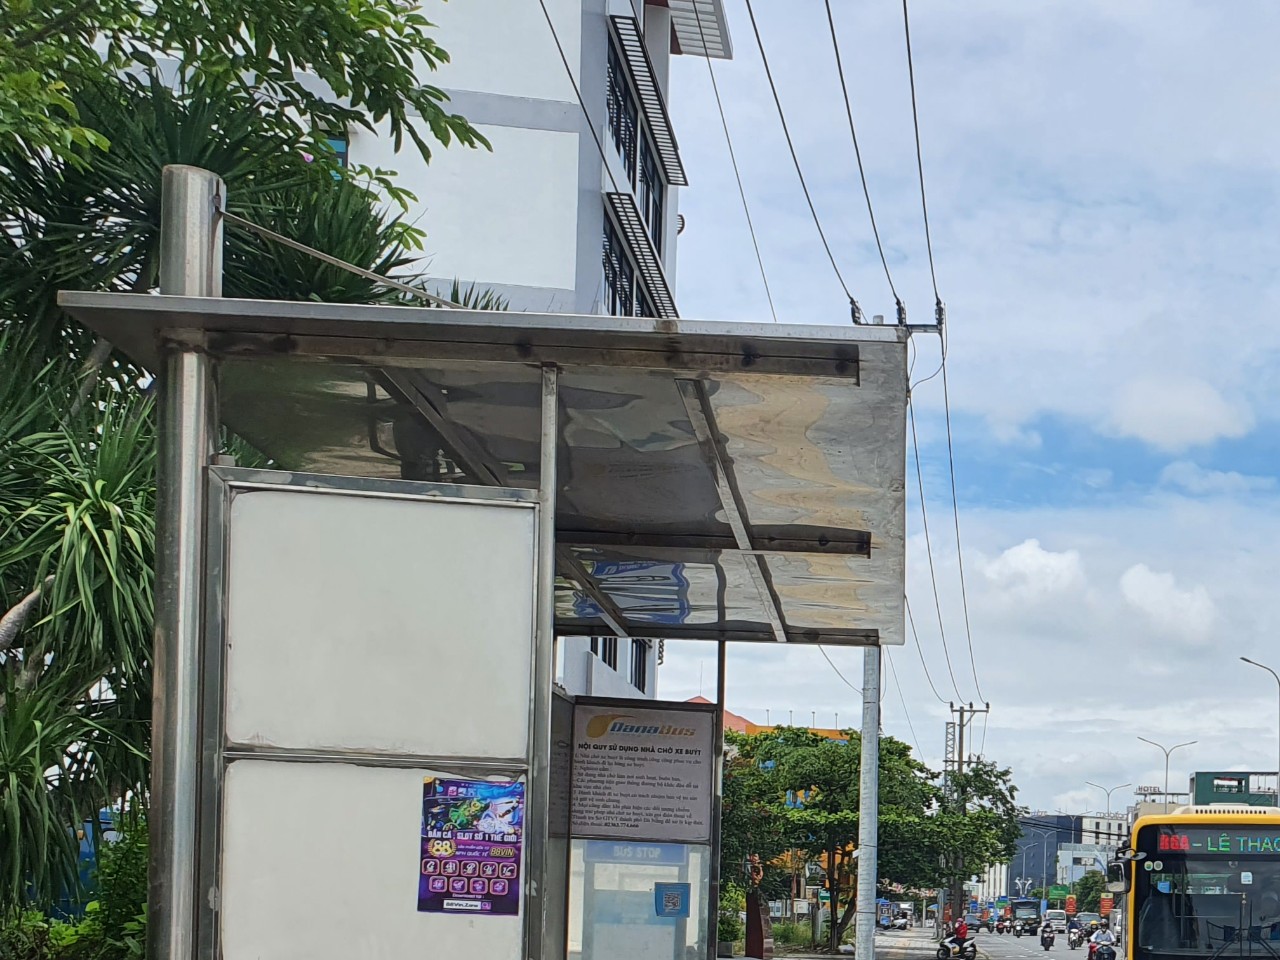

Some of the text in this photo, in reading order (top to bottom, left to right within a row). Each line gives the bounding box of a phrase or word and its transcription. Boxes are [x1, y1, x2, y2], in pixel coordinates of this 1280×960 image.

[610, 722, 696, 736] DanaBus
[578, 742, 591, 751] NỘI
[609, 743, 618, 751] SỬ
[619, 745, 639, 753] DỤNG
[641, 745, 655, 753] NHÀ
[657, 746, 674, 754] CHỜ
[1138, 785, 1162, 793] HOTEL
[1207, 832, 1230, 852] LÊ
